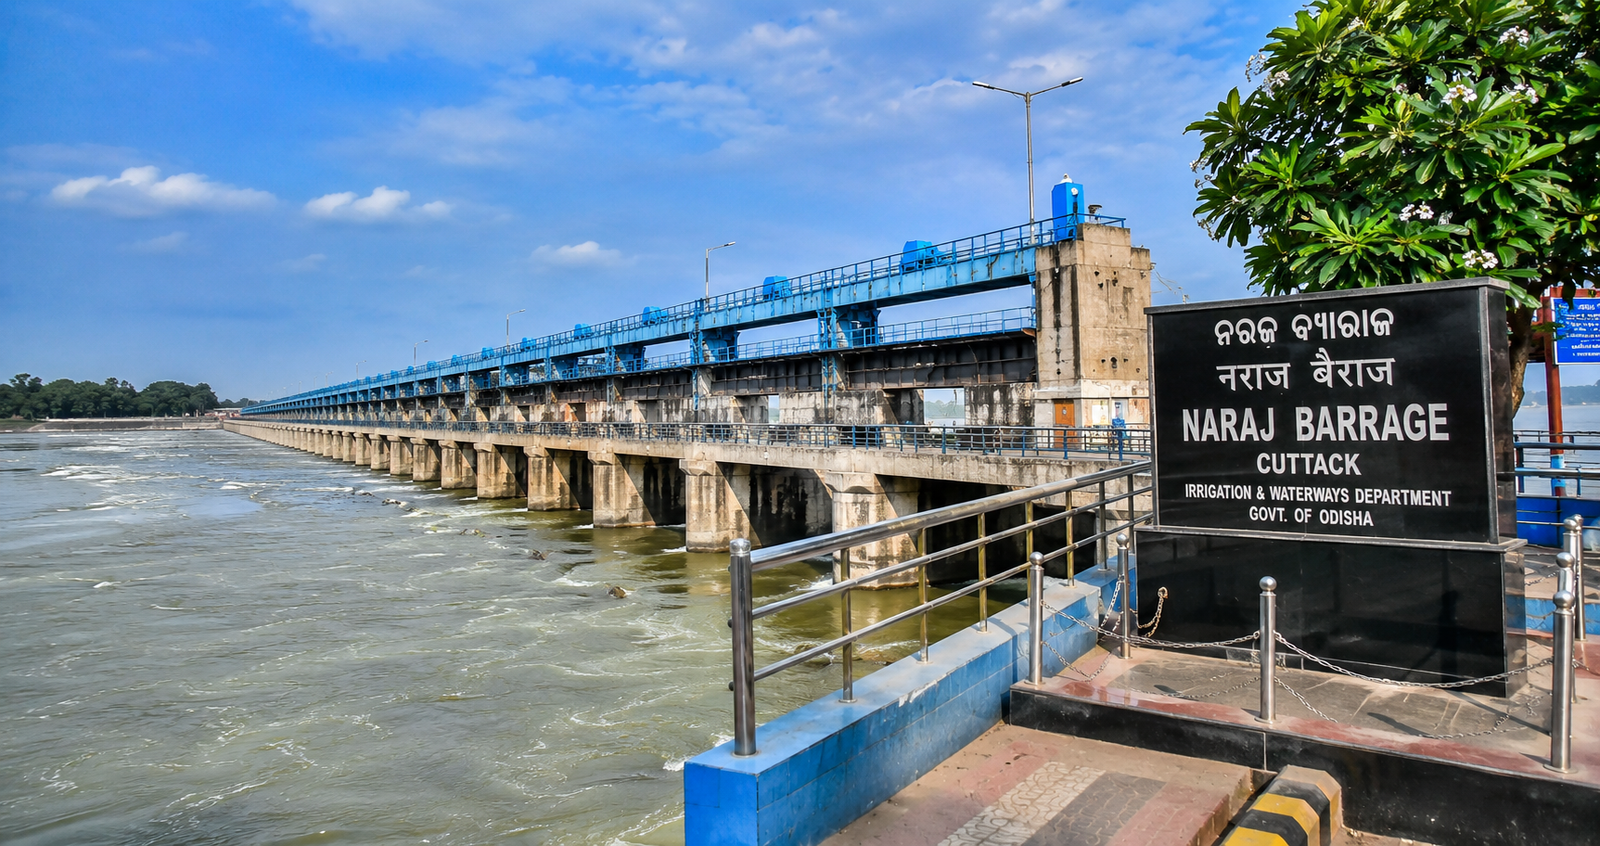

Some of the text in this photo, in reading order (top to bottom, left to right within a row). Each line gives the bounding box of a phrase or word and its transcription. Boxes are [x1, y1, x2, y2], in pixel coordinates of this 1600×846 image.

[1216, 347, 1395, 391] नराज बैराज
[1183, 403, 1449, 441] NARAJ BARRAGE
[1257, 453, 1361, 475] CUTTACK
[1185, 484, 1451, 506] IRRIGATION & WATERWAYS DEPARTMENT
[1249, 506, 1373, 526] GOVT. OF ODISHA
